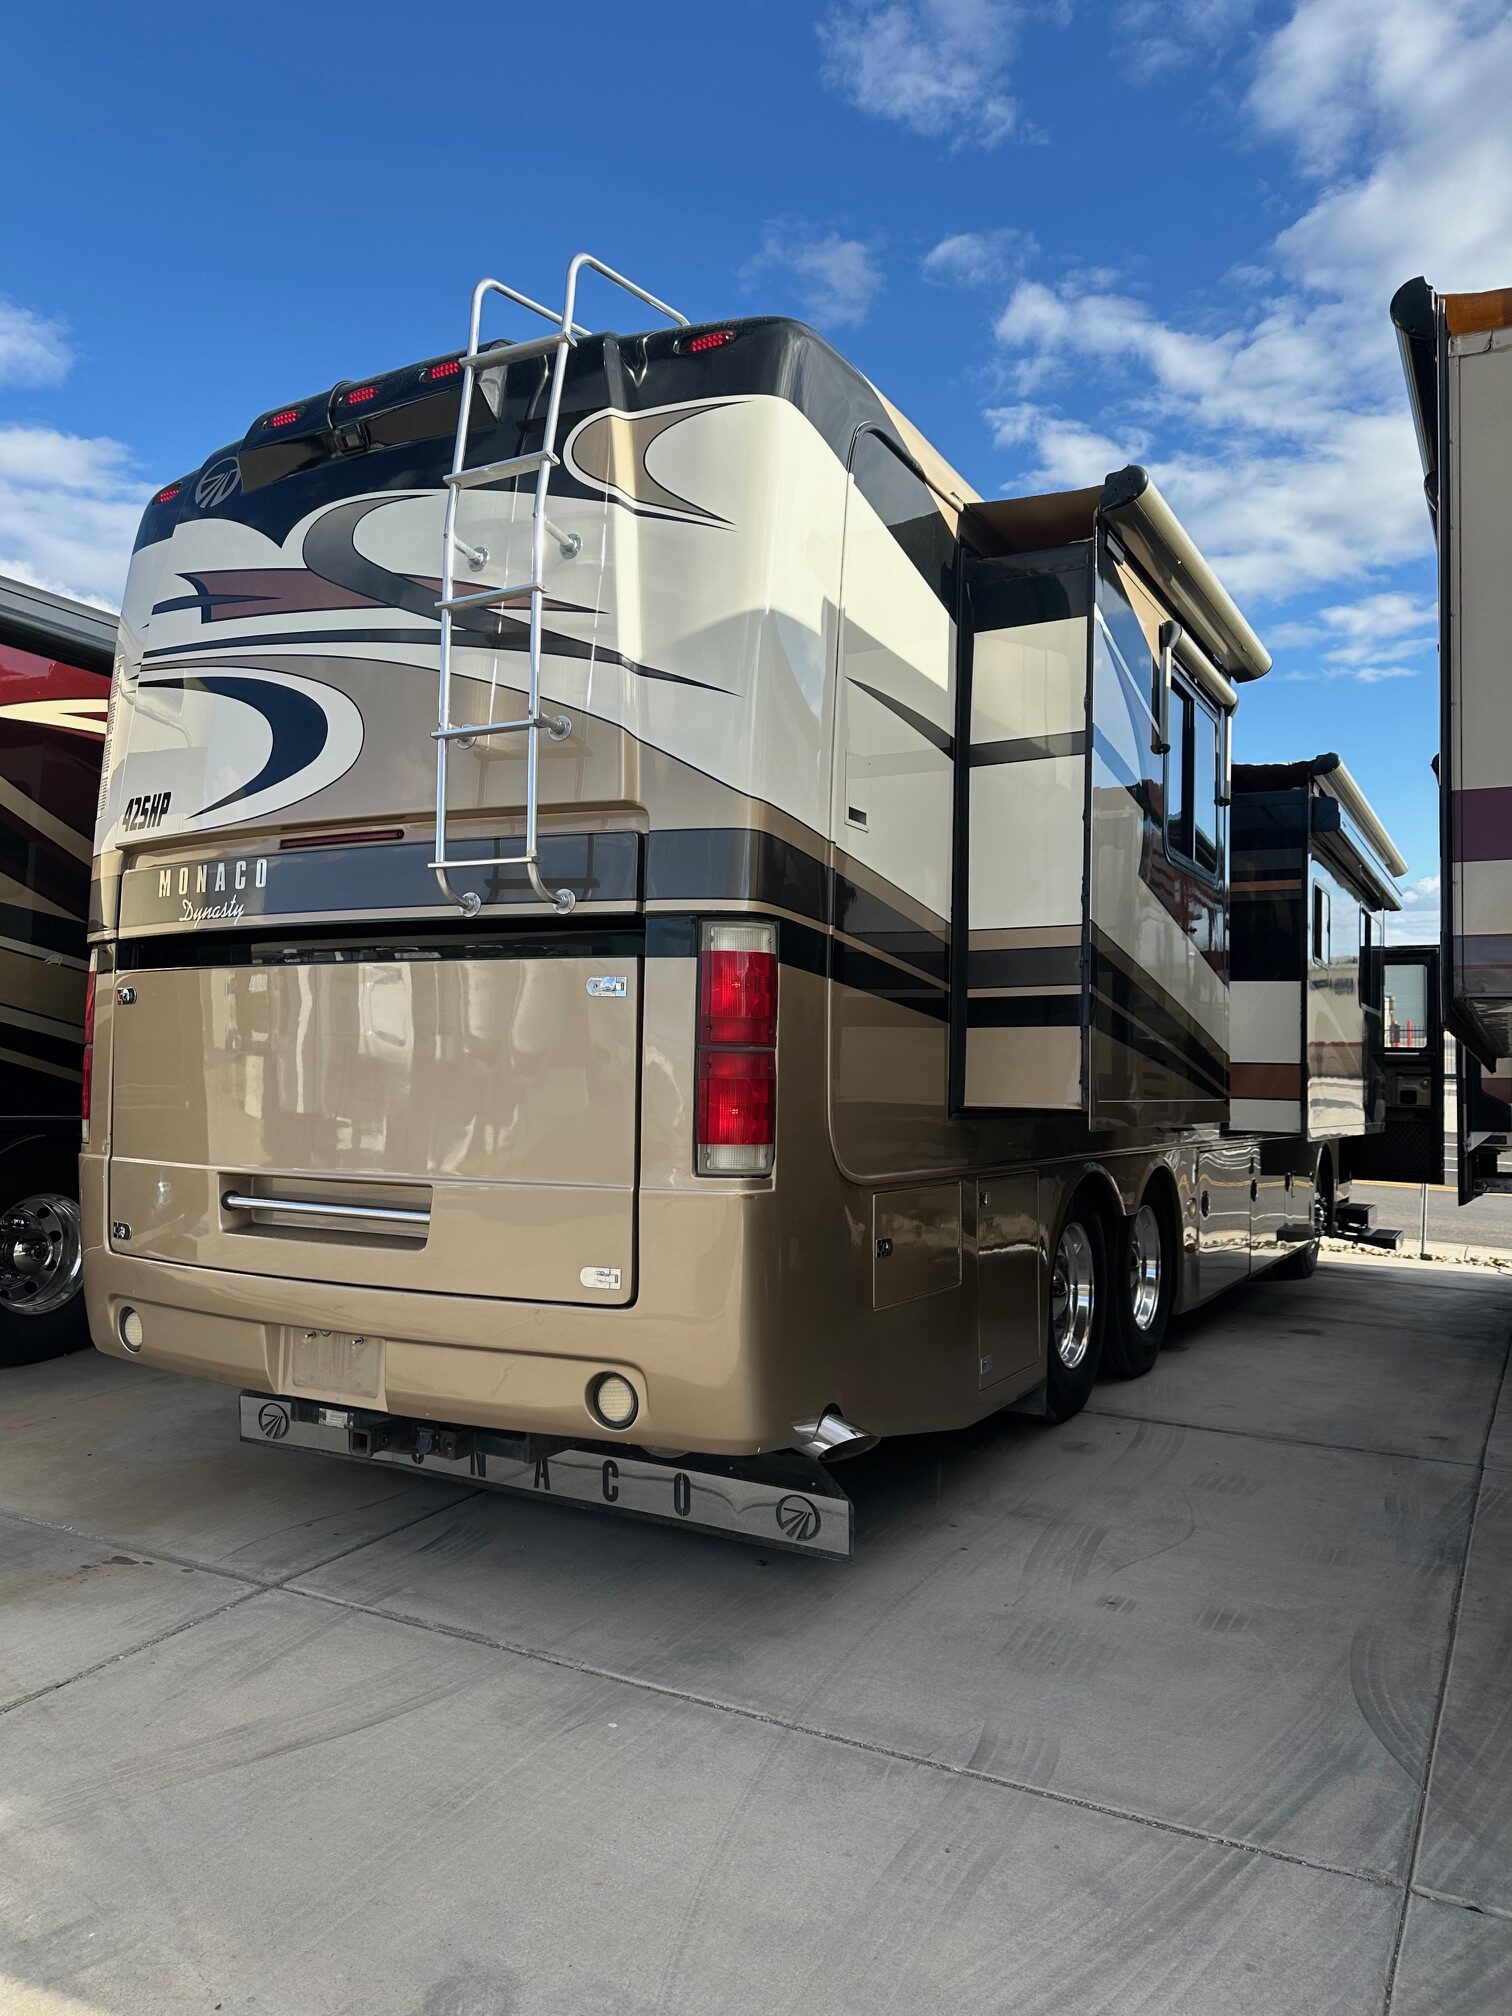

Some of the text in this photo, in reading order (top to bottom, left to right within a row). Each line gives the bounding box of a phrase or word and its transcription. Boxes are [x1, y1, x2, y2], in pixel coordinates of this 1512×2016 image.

[121, 791, 171, 832] 425HP
[158, 858, 267, 898] MONACO
[178, 894, 244, 929] Dynasty
[411, 1452, 691, 1517] NACO
